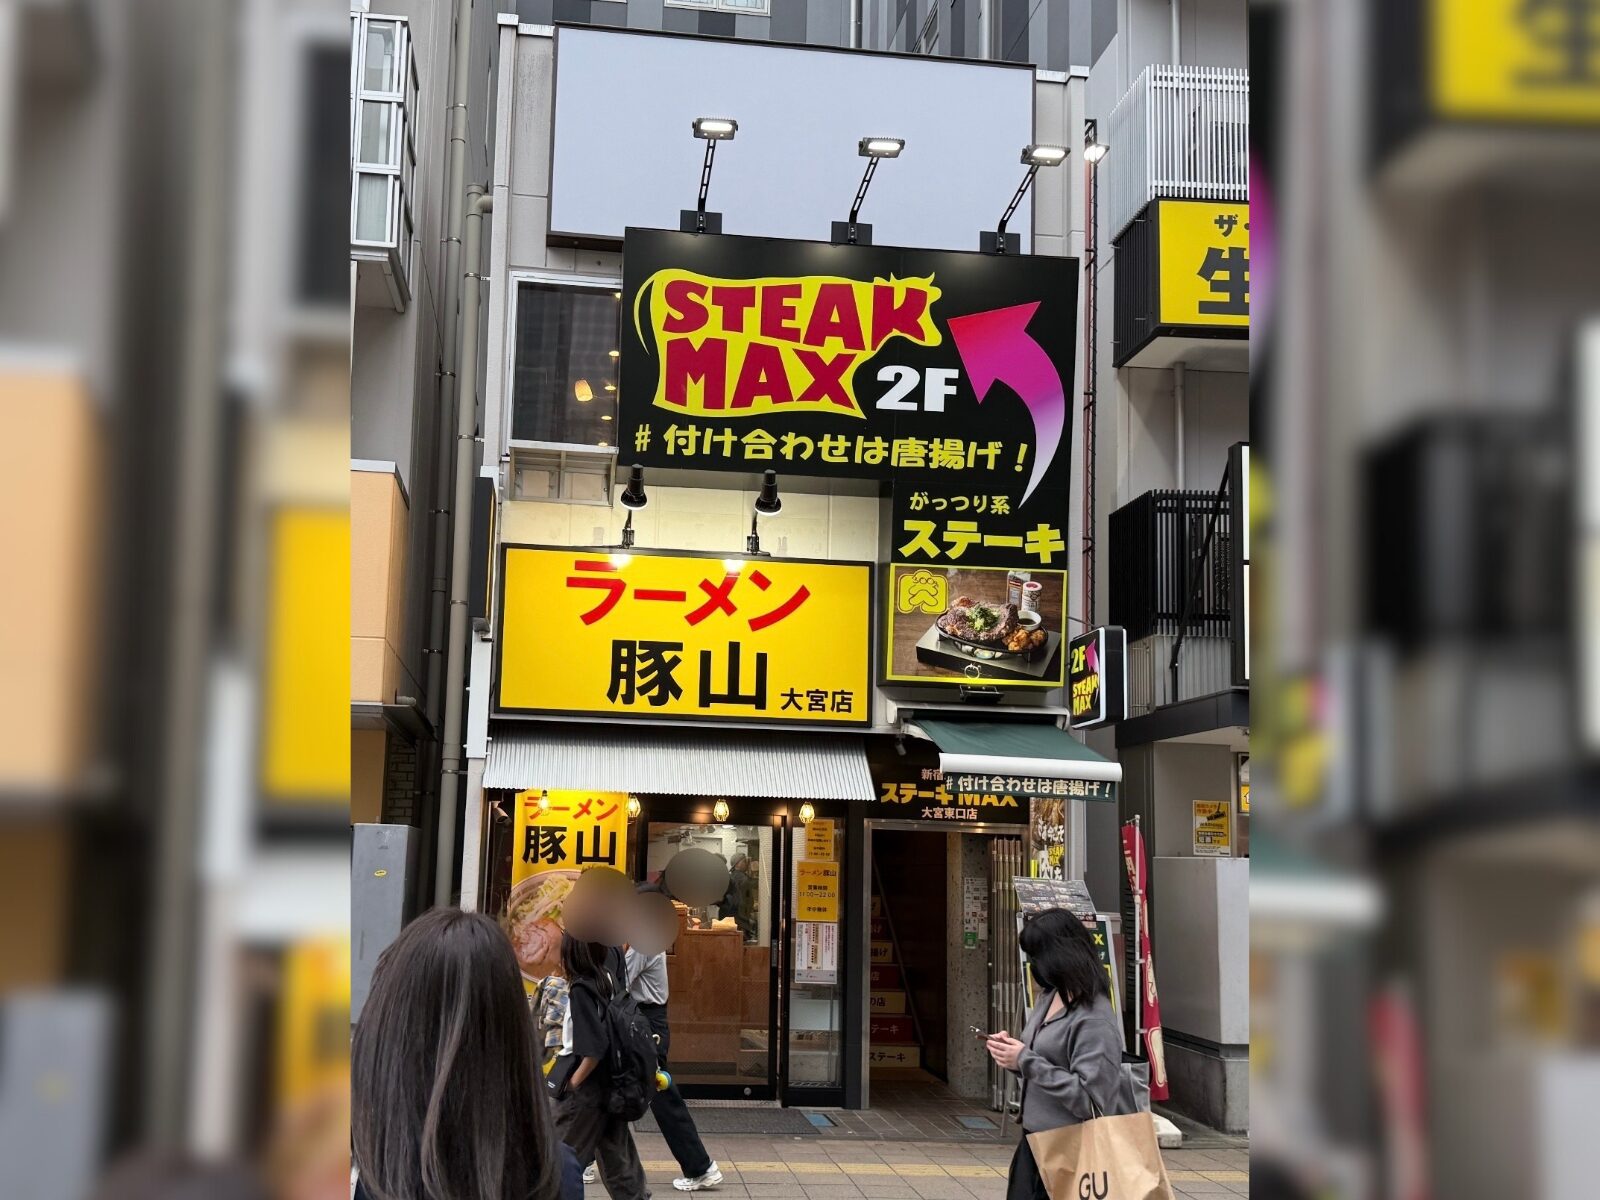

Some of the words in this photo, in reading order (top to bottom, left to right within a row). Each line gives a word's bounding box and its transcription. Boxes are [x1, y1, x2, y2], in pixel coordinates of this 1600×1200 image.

[663, 280, 928, 351] STEAK
[664, 337, 857, 410] MAX
[875, 365, 960, 413] 2F
[909, 491, 1010, 515] がっつり系
[898, 519, 1065, 564] ステーキ
[566, 559, 811, 632] ラーメン
[1071, 645, 1086, 673] 2F
[606, 639, 768, 710] 豚山
[780, 688, 854, 713] 大宮店
[1073, 674, 1098, 697] STEAK
[1073, 694, 1091, 716] MAX
[524, 796, 619, 820] ラーメン
[881, 782, 954, 806] ステーキ
[921, 806, 978, 820] 大宮東口店
[522, 825, 616, 866] 豚山
[1079, 1171, 1108, 1200] GU
